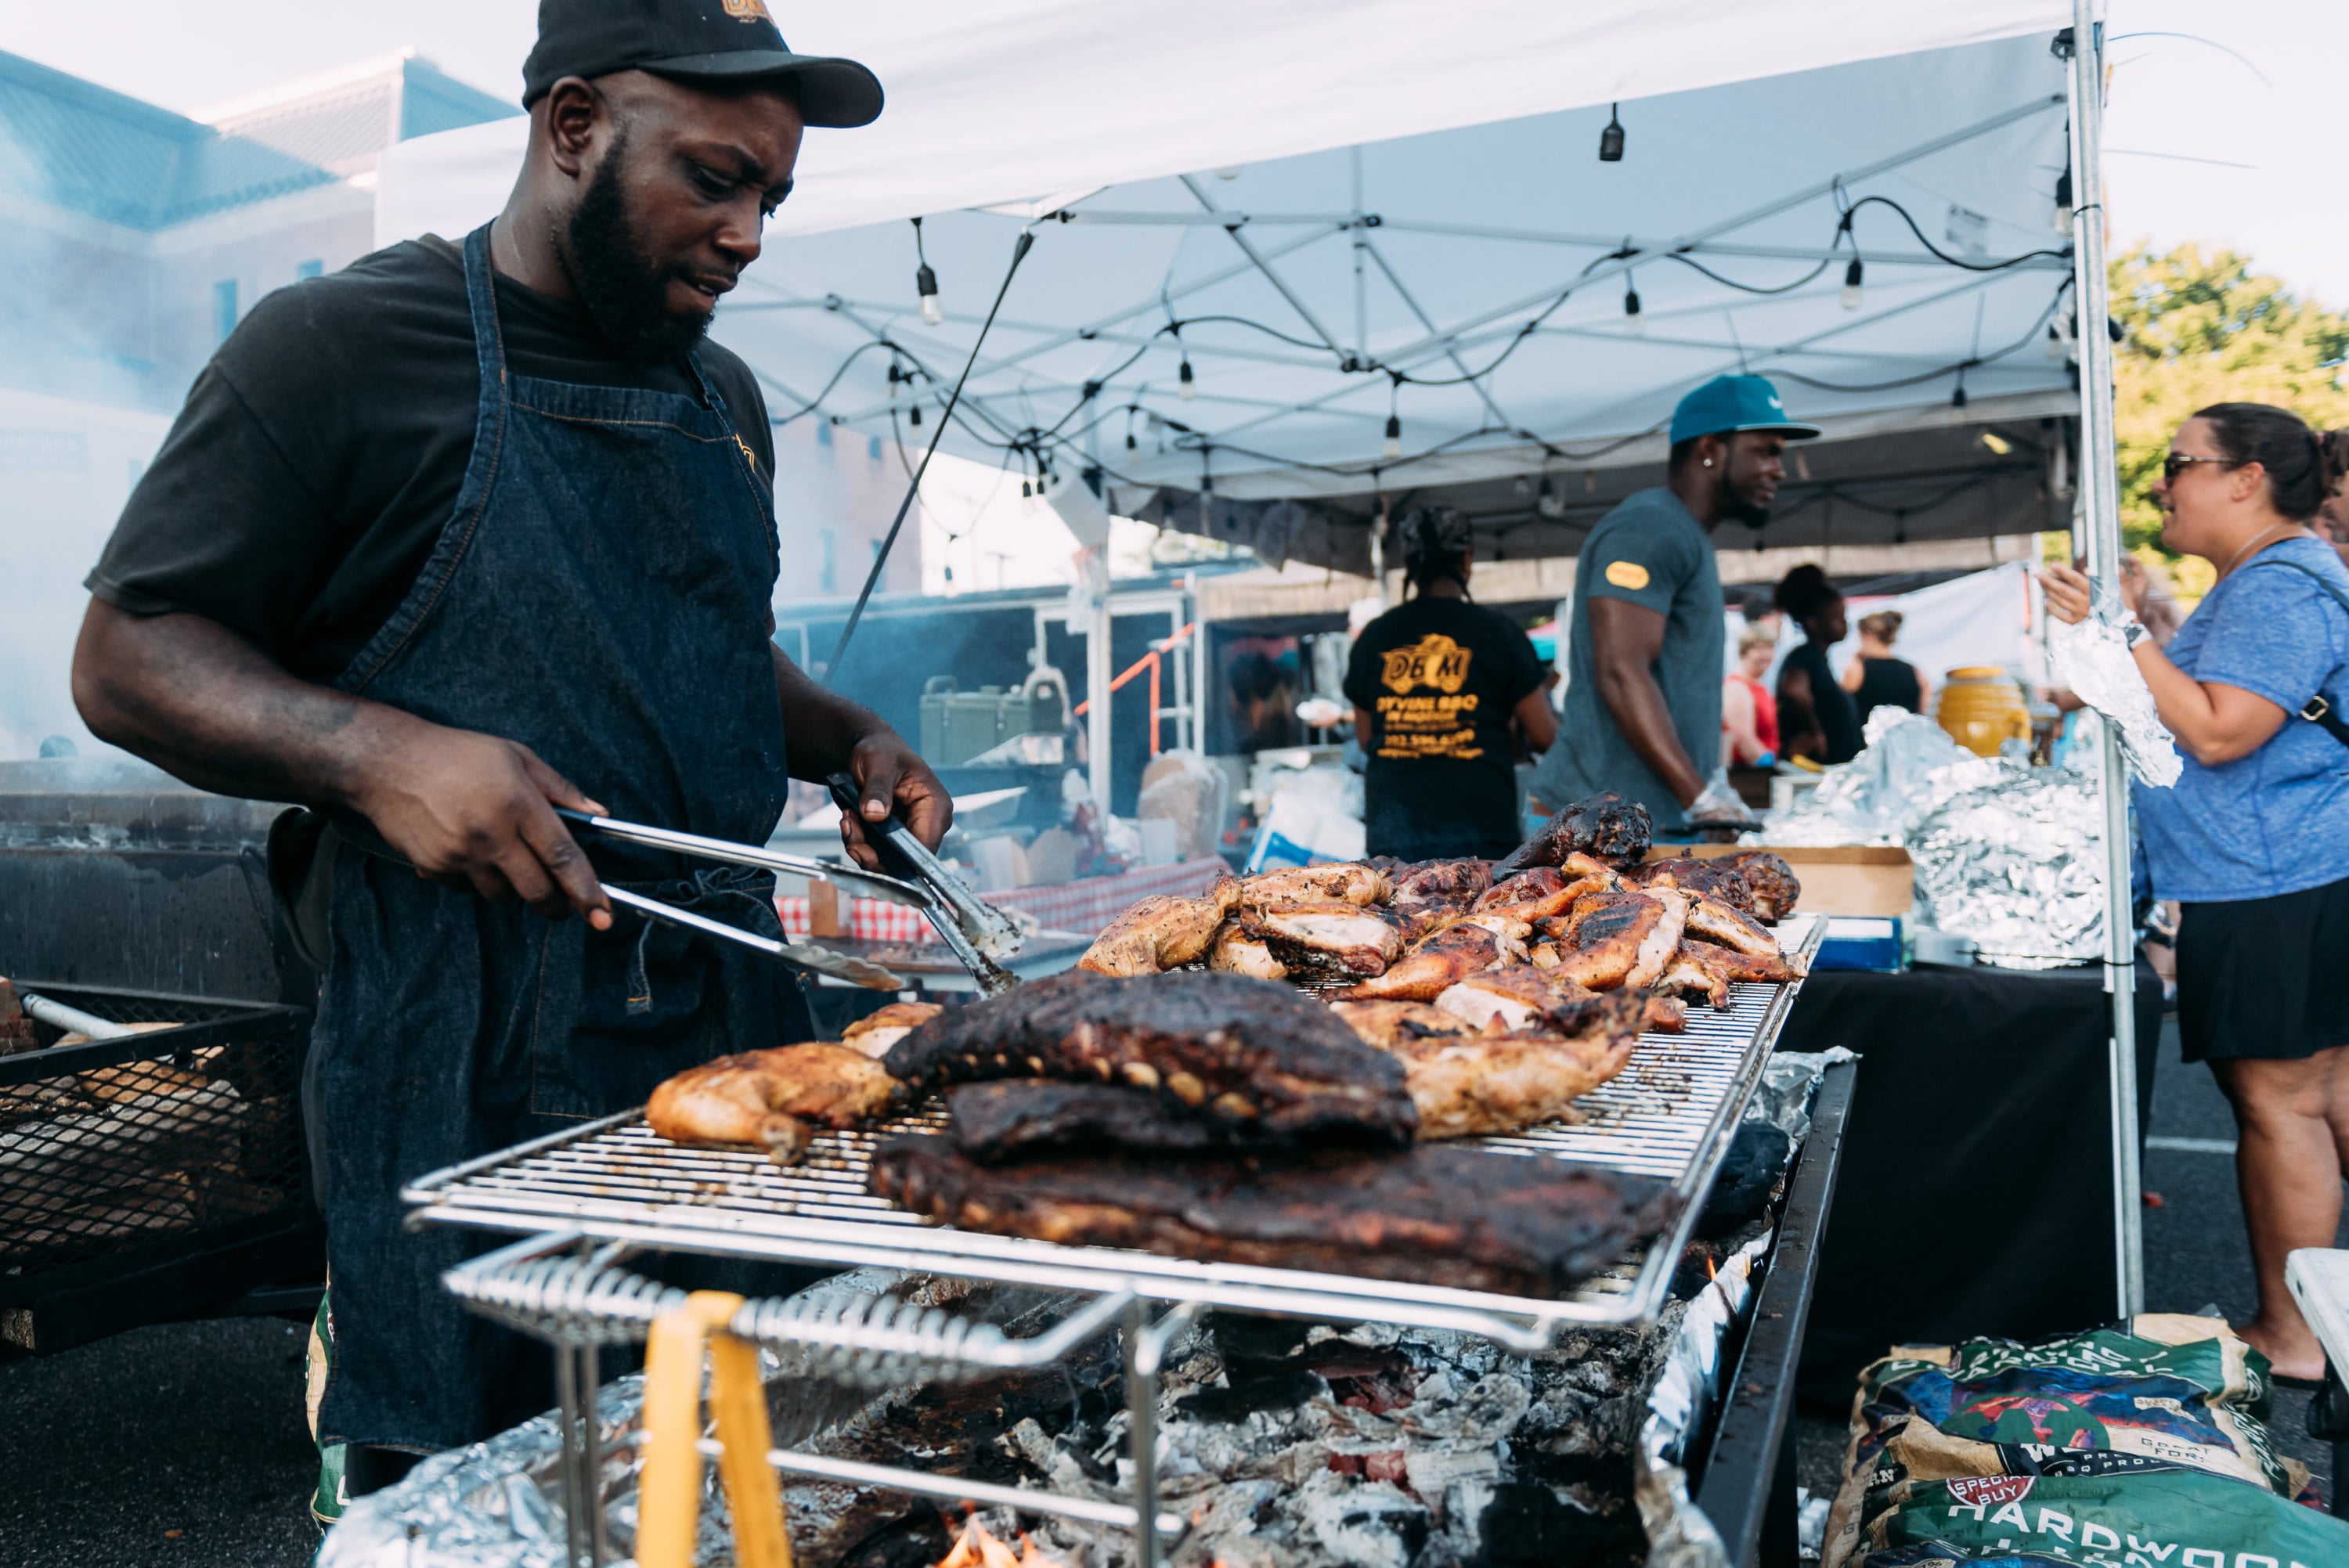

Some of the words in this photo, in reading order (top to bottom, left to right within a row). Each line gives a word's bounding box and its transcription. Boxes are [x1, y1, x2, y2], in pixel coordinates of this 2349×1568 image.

[1954, 1476, 2030, 1497] SPECI
[1978, 1484, 2016, 1505] BUY
[1948, 1501, 2316, 1568] HARDWOO
